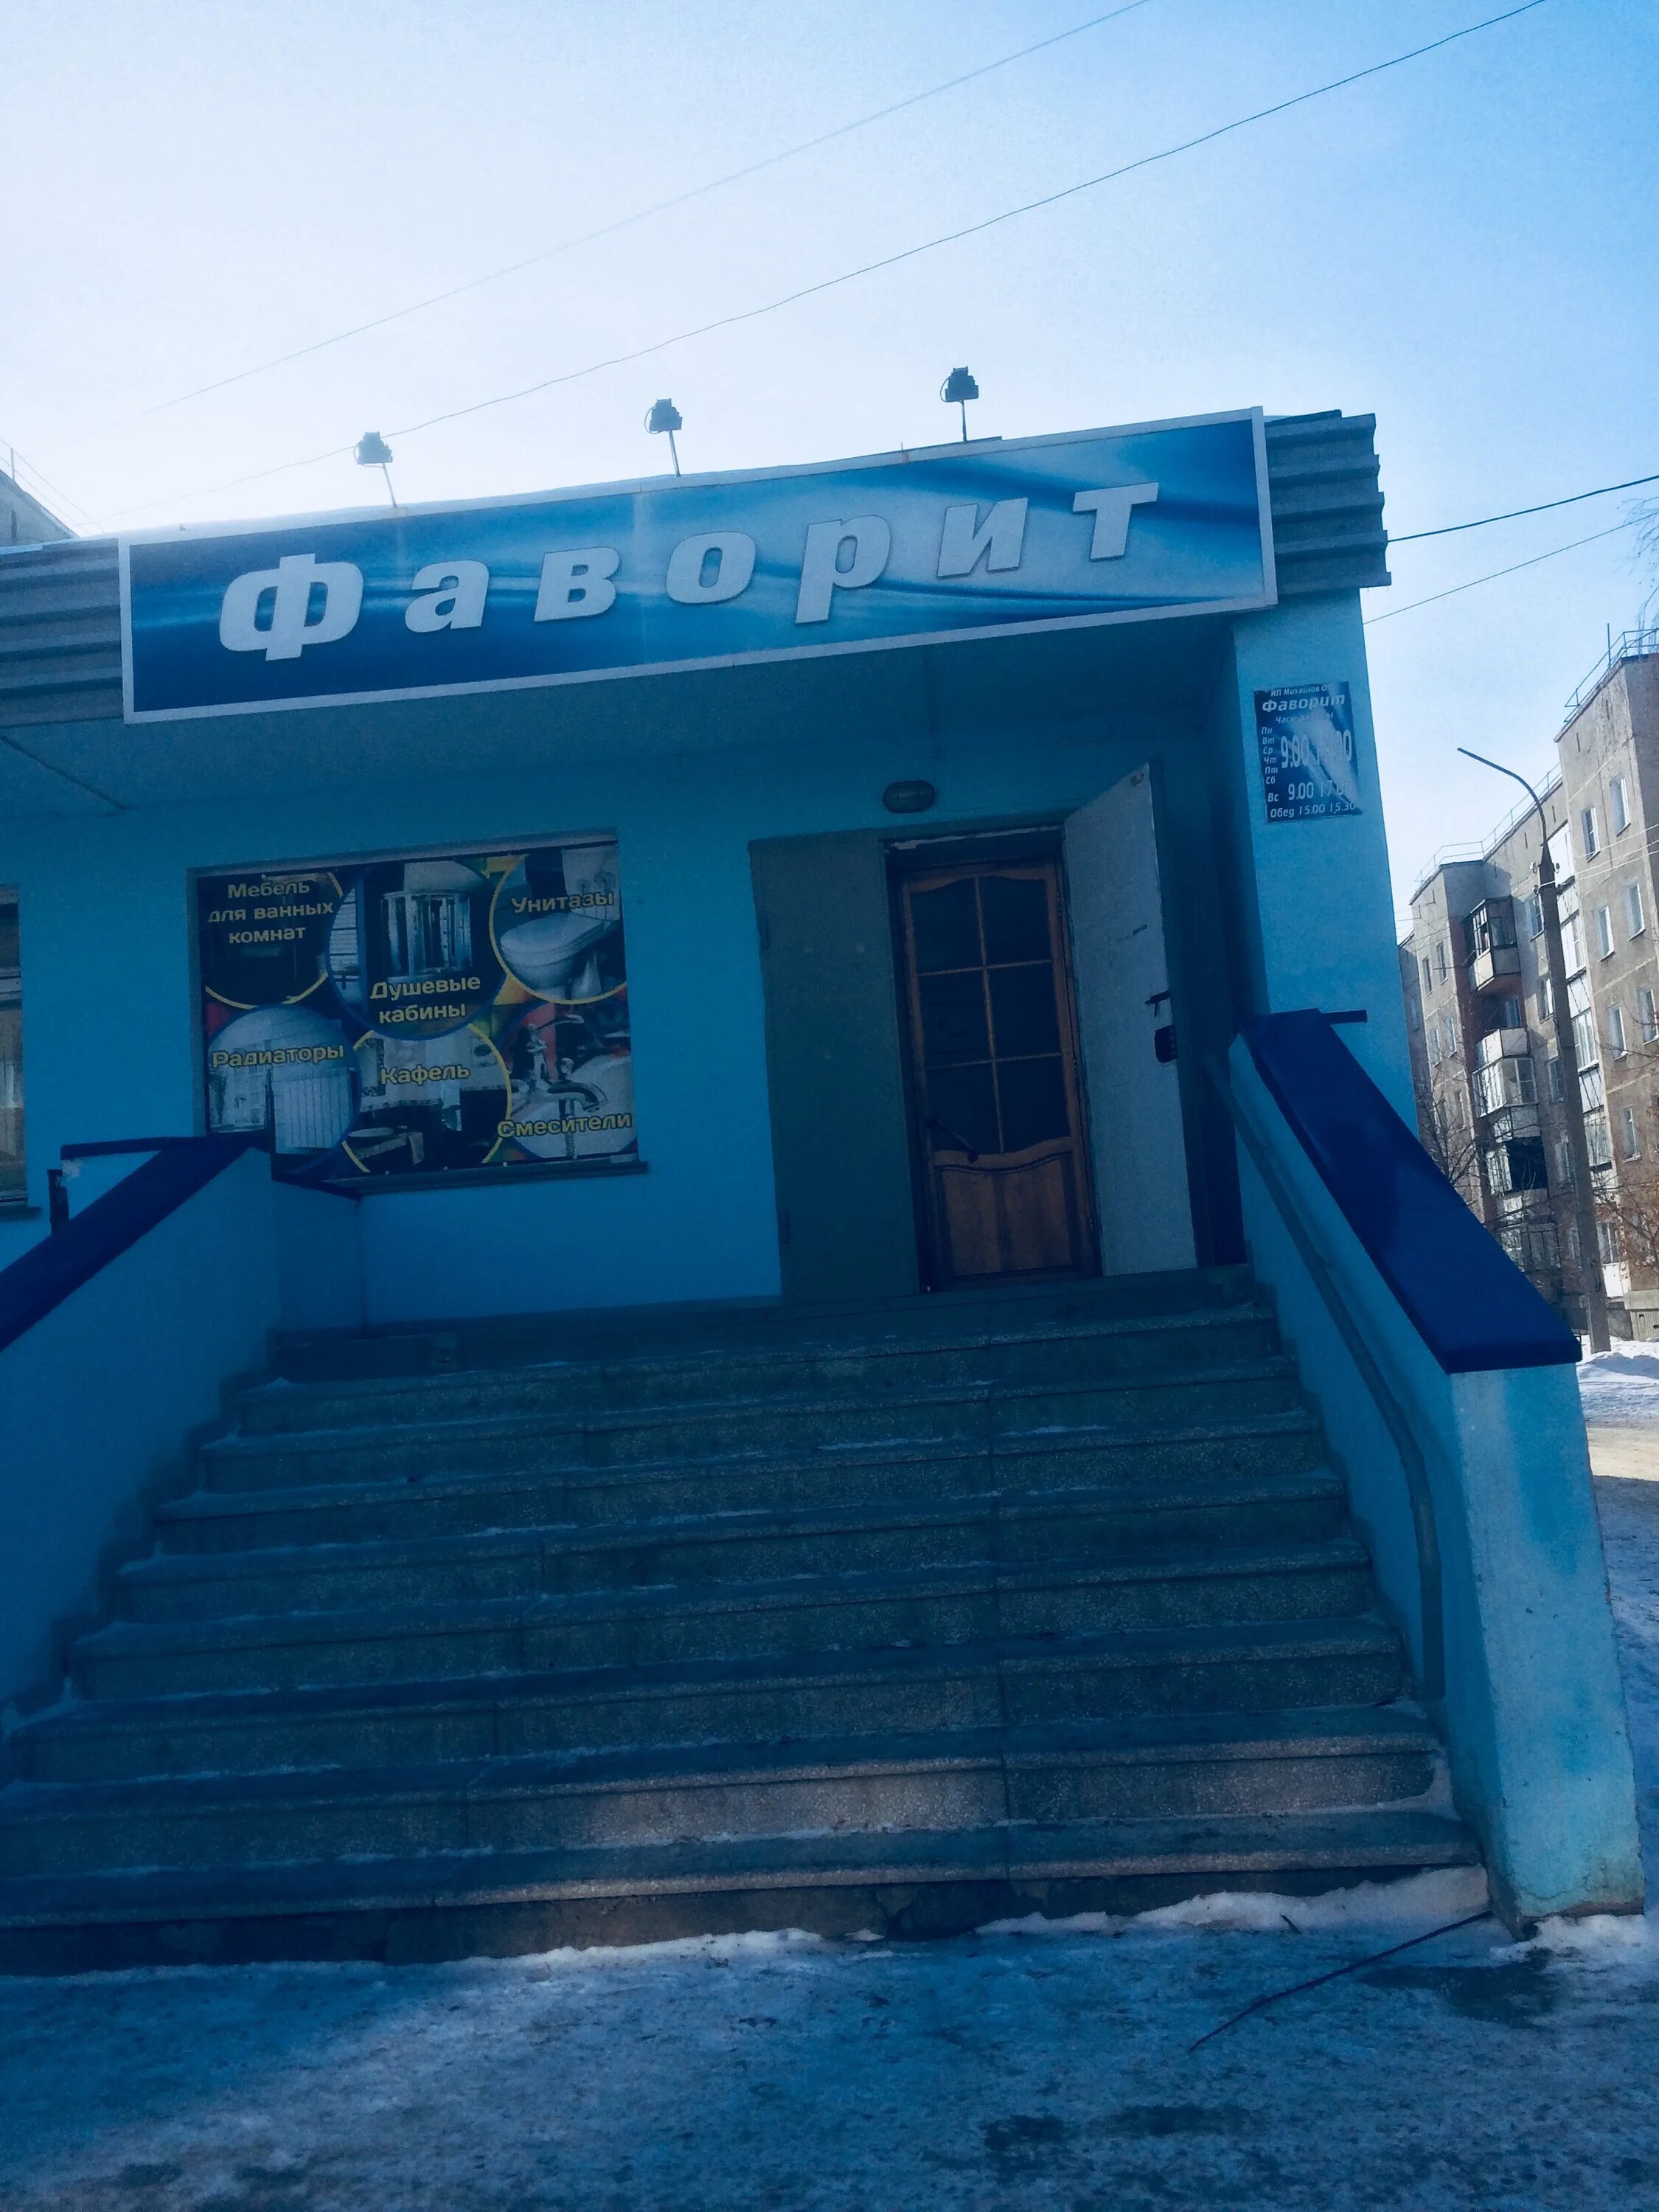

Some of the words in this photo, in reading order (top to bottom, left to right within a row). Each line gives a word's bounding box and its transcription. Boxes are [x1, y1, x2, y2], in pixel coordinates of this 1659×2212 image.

[220, 483, 1158, 661] Фаворит
[1271, 689, 1281, 697] ИП
[1262, 695, 1345, 712] Фаворит
[1262, 727, 1273, 735] Пн
[1262, 737, 1275, 745] Вт
[1263, 746, 1273, 755] Ср
[1264, 756, 1277, 765] Чт
[1265, 766, 1278, 775] Пт
[1266, 776, 1276, 785] Сб
[1267, 793, 1279, 802] Вс
[1288, 782, 1314, 801] 9.00
[1270, 808, 1295, 818] Обед
[1299, 804, 1326, 815] 15.00
[228, 880, 310, 900] Мебель
[208, 908, 246, 922] для
[254, 902, 334, 919] ванных
[512, 891, 615, 914] Унитазы
[229, 926, 306, 944] комнат
[370, 977, 481, 1001] Душевые
[379, 1003, 466, 1024] кабины
[212, 1045, 344, 1068] Радиаторы
[380, 1065, 470, 1086] Кафель
[497, 1113, 632, 1139] Смесители
